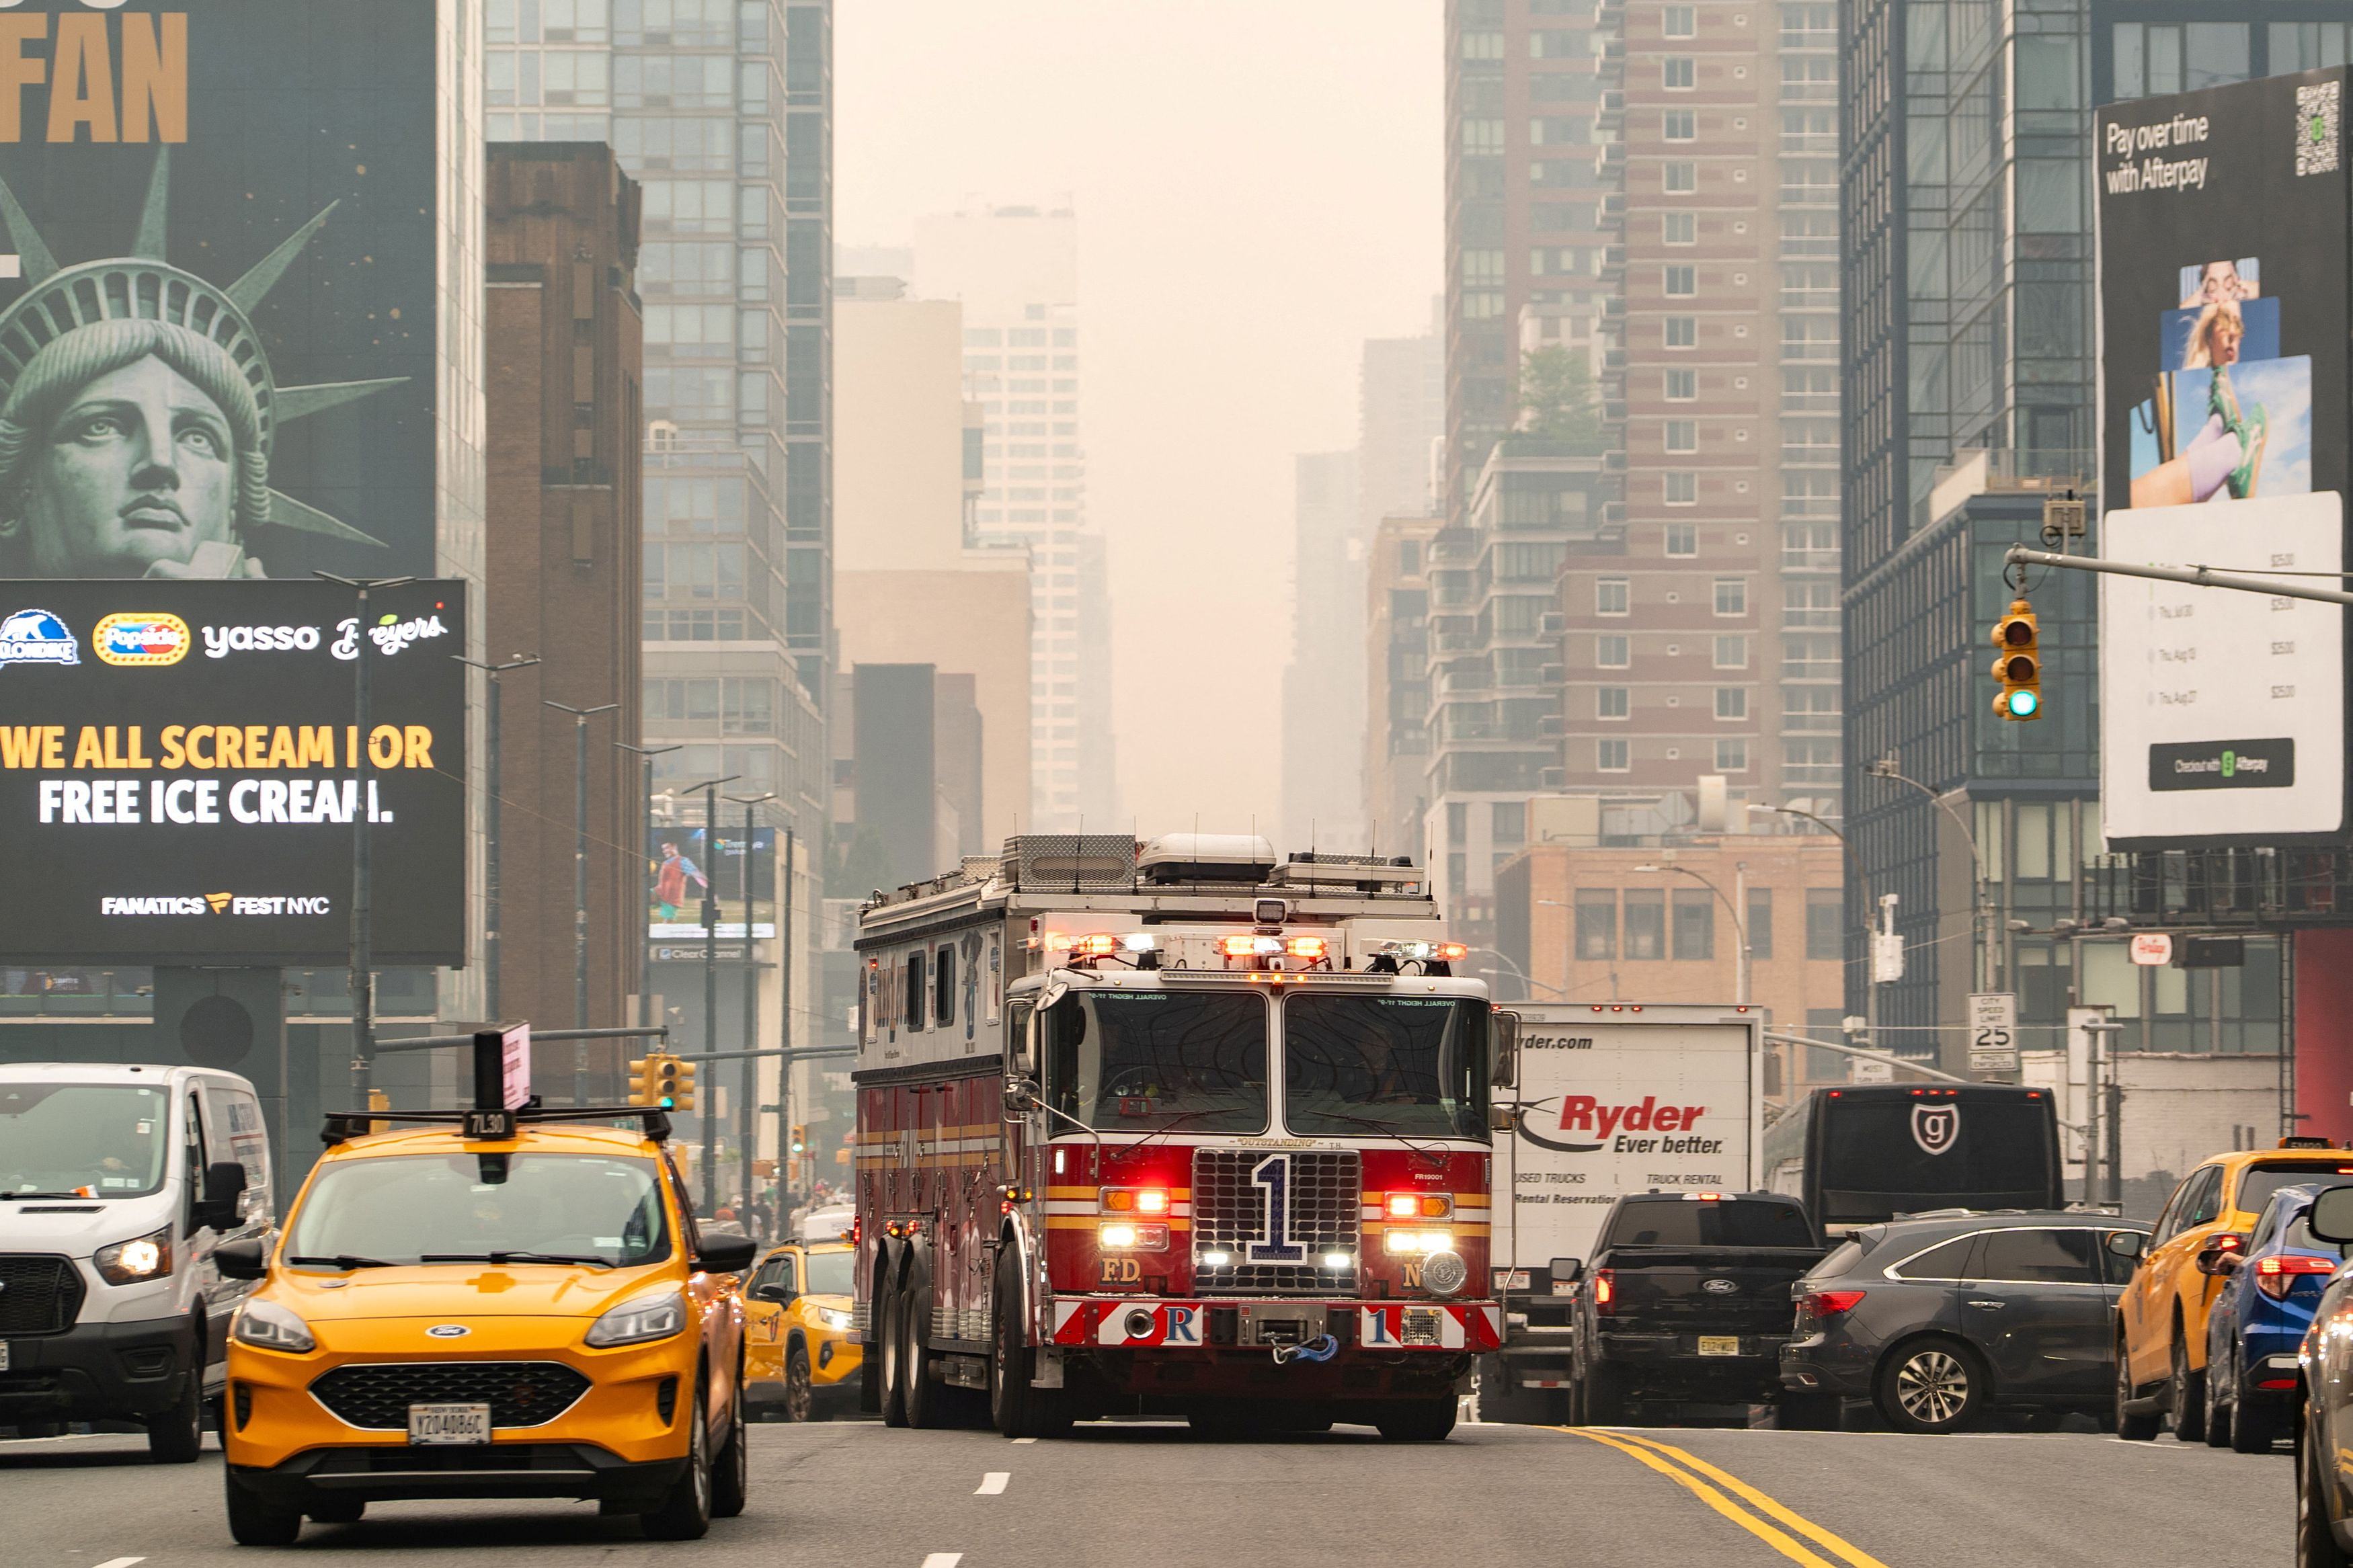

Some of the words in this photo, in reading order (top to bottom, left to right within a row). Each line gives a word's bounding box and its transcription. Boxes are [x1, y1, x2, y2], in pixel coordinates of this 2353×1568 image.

[0, 12, 188, 143] FAN
[2106, 123, 2136, 159] Pay
[2137, 122, 2172, 151] over
[2173, 113, 2208, 145] time
[2106, 161, 2139, 194] with
[2140, 157, 2208, 193] Afterpay
[202, 626, 320, 658] yasso
[0, 725, 65, 769] WE
[73, 725, 153, 769] ALL
[159, 725, 335, 769] SCREAM
[39, 780, 141, 823] FREE
[151, 780, 219, 824] ICE
[102, 897, 206, 915] FANATICS
[233, 897, 285, 915] FEST
[287, 897, 330, 915] NYC
[672, 950, 698, 958] Clear
[699, 949, 742, 958] Cannel
[1515, 1034, 1593, 1050] yder.com
[1976, 1025, 2009, 1046] 25
[472, 1114, 504, 1134] 7L30
[1559, 1096, 1705, 1139] Ryder
[1925, 1115, 1948, 1144] g
[1613, 1136, 1658, 1153] Ever
[1662, 1136, 1723, 1154] better.
[1515, 1173, 1542, 1184] USED
[1545, 1173, 1586, 1184] TRUCKS
[1647, 1174, 1681, 1184] TRUCK
[1683, 1174, 1724, 1184] RENTAL
[1246, 1153, 1308, 1265] 1
[1515, 1194, 1549, 1204] Rental
[1101, 1257, 1142, 1282] F.D.
[1164, 1307, 1199, 1342] R
[1367, 1308, 1393, 1344] 1
